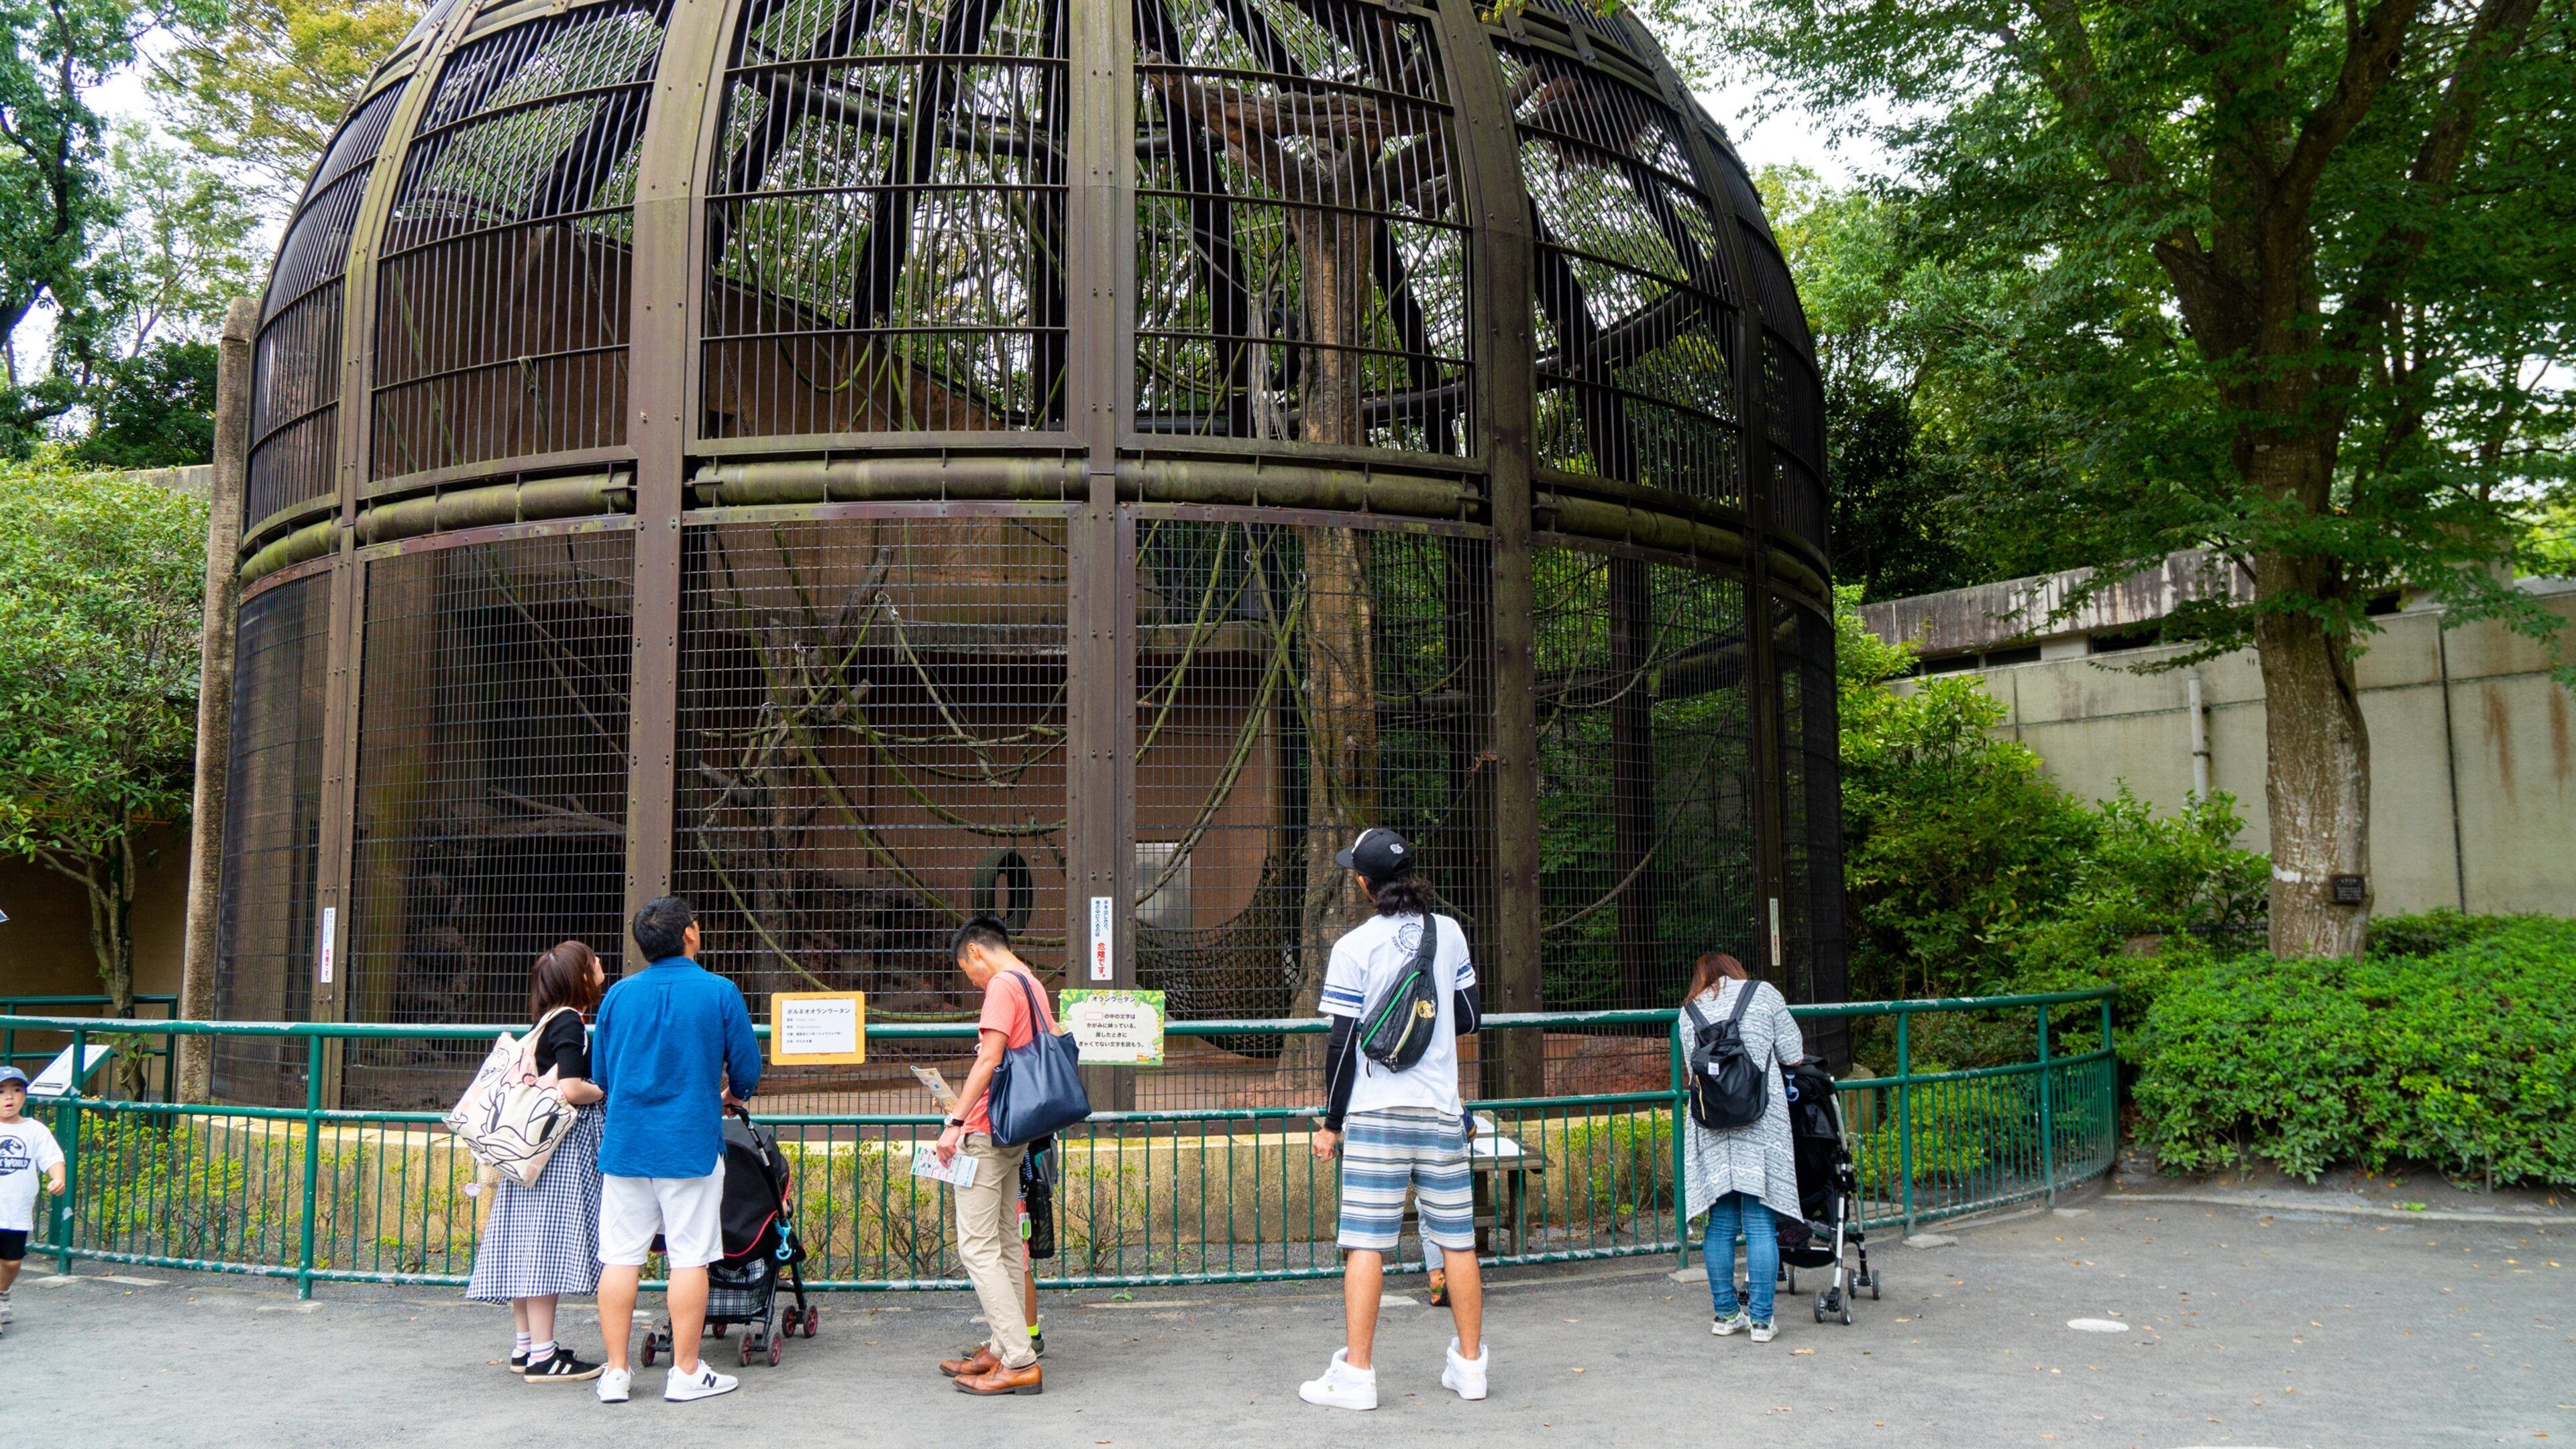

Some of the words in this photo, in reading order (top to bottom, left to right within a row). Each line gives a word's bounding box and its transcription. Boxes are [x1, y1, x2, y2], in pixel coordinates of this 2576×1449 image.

[1097, 943, 1106, 977] 危険です。
[4, 1158, 28, 1167] WORLD
[702, 1373, 717, 1388] N
